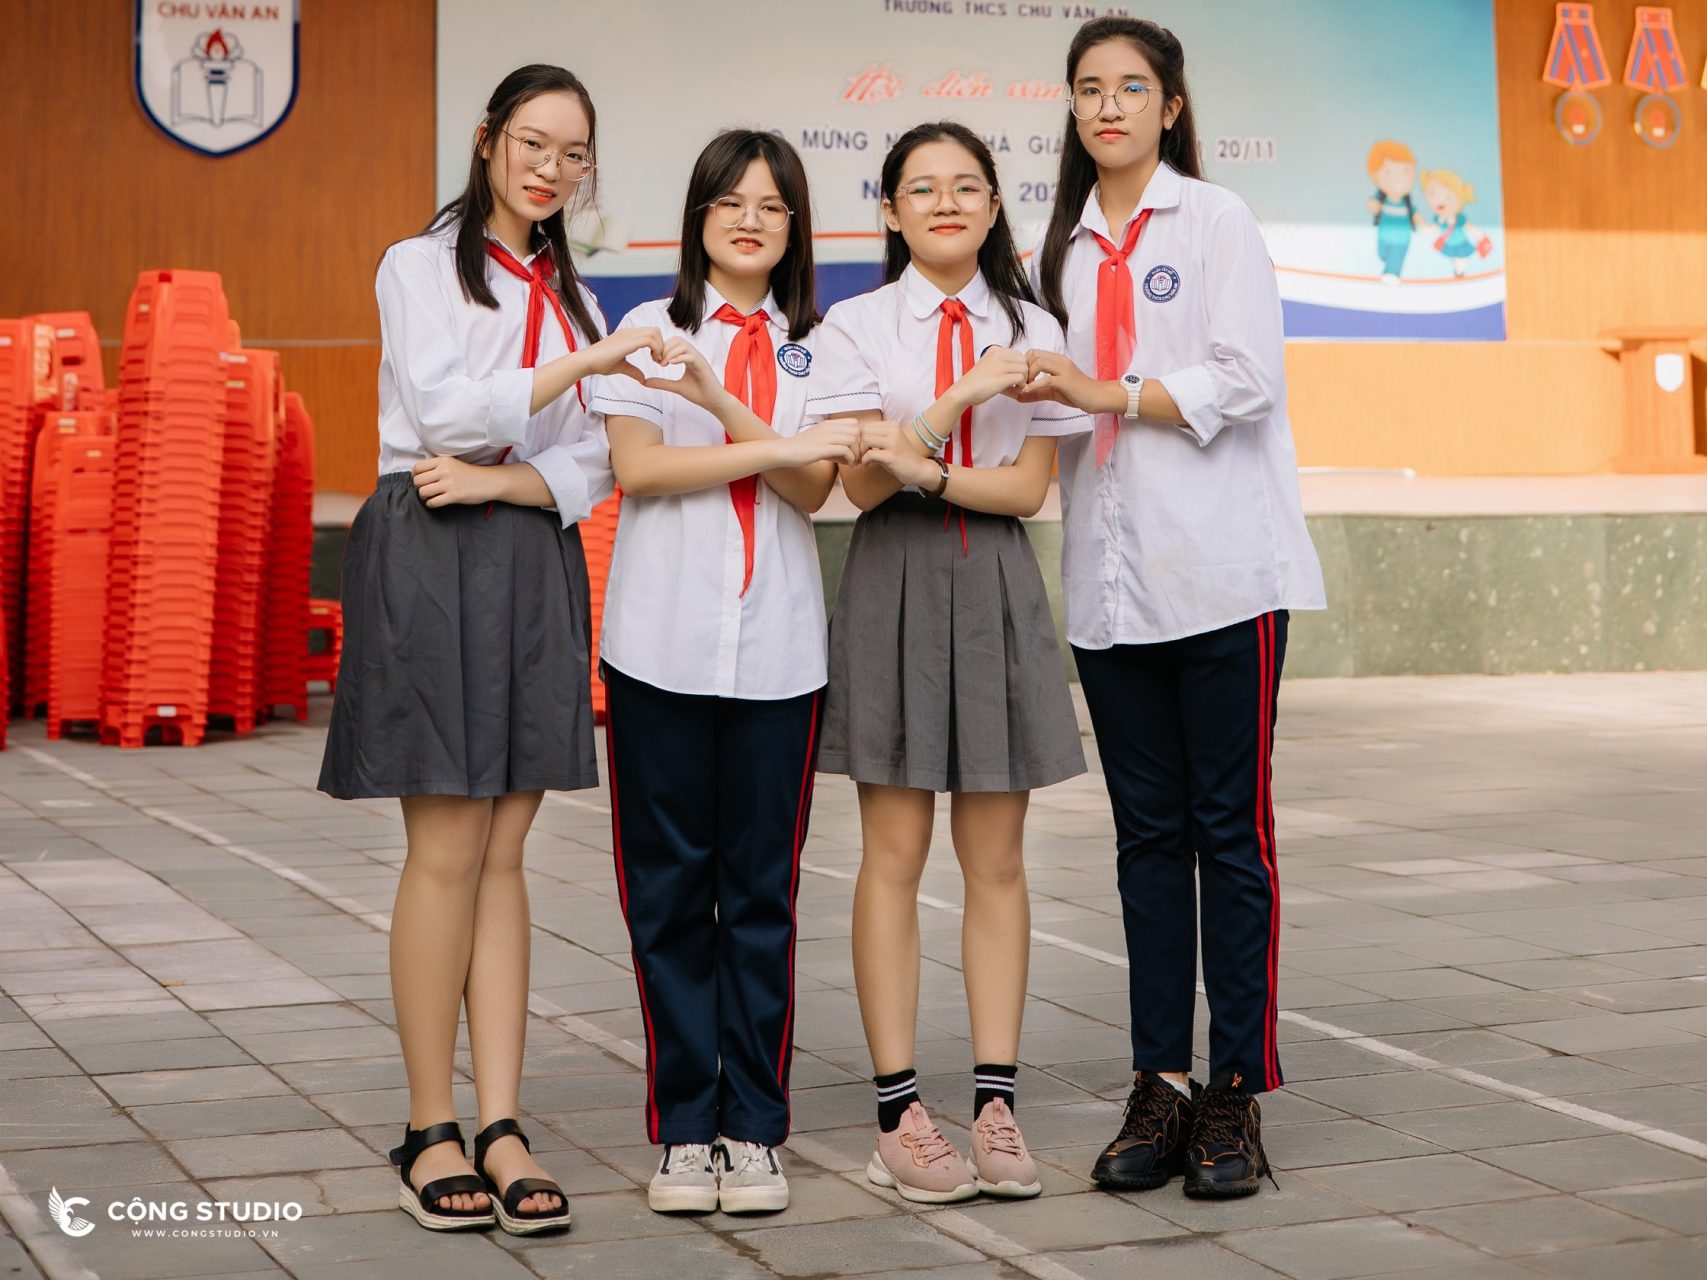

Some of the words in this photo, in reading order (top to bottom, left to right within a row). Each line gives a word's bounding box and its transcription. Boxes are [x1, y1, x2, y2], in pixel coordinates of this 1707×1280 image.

[157, 1, 200, 18] CHU
[251, 6, 279, 20] AN
[965, 0, 1007, 17] THCS
[1018, 3, 1052, 18] CHU
[1218, 139, 1273, 160] 20/11
